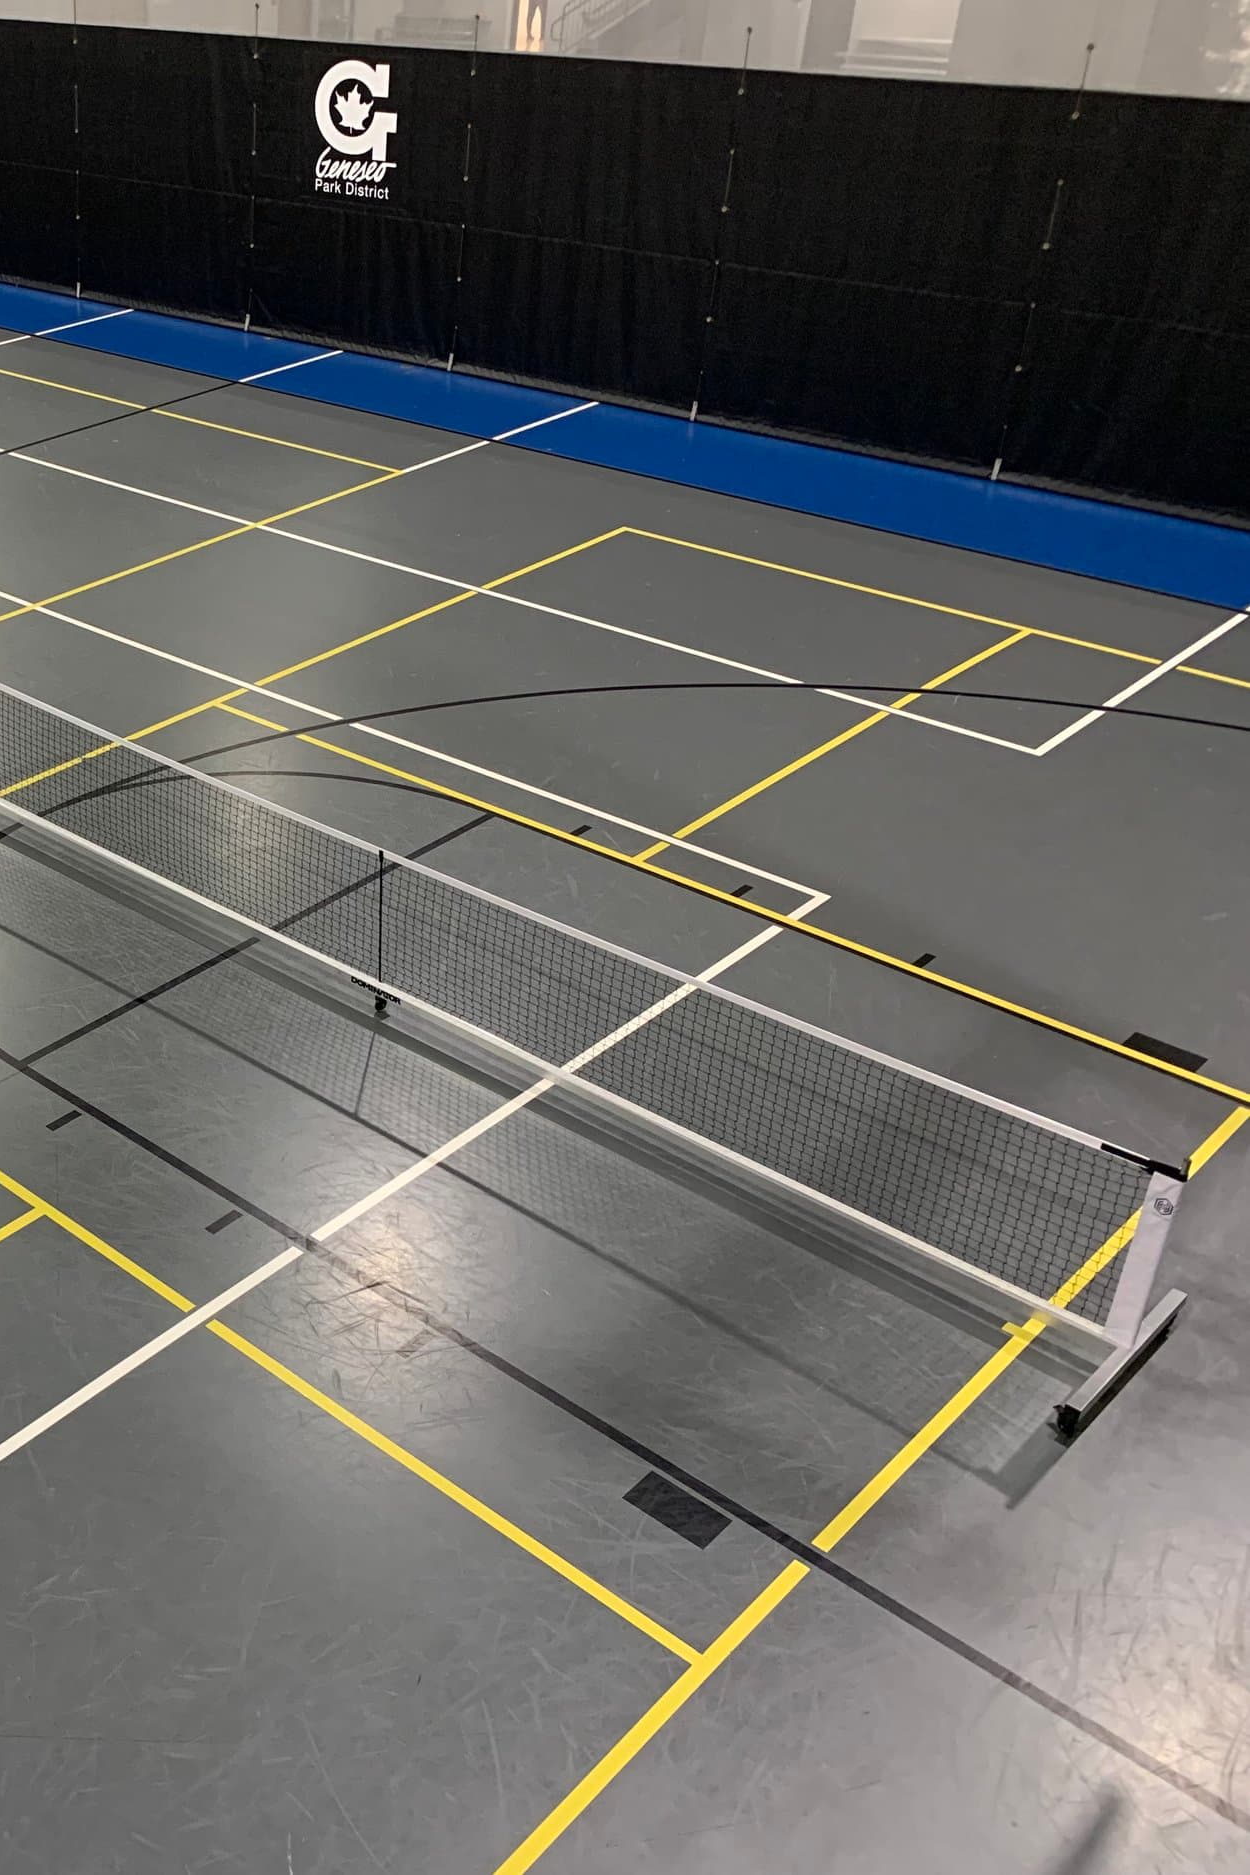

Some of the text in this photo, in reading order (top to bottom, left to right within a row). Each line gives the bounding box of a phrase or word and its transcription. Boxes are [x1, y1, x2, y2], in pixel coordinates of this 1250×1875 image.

[315, 60, 397, 161] G
[315, 146, 397, 183] Geneseo
[315, 178, 389, 200] Park District
